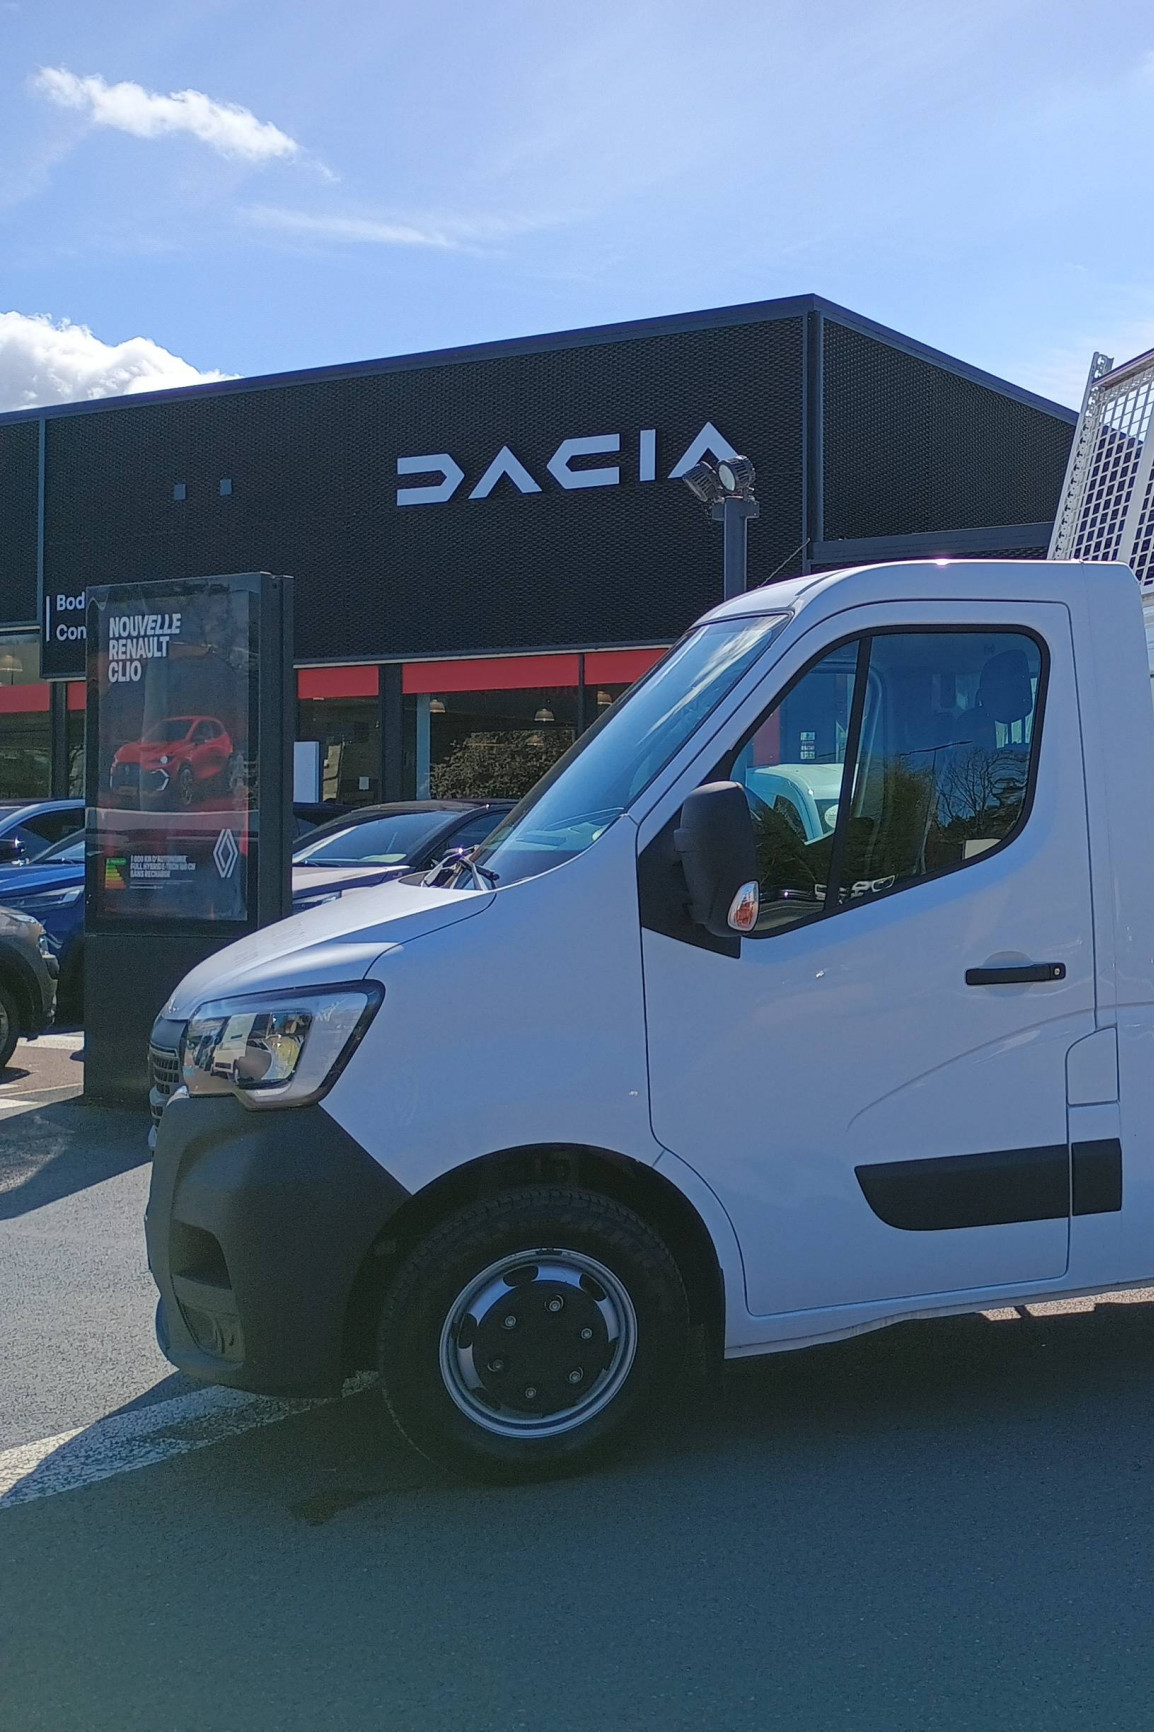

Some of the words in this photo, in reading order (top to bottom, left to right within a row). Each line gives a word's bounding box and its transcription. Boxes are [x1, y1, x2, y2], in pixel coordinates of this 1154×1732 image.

[397, 421, 747, 506] DACIA
[109, 613, 182, 638] NOUVELLE
[109, 636, 170, 660] RENAULT
[108, 660, 142, 682] CLIO
